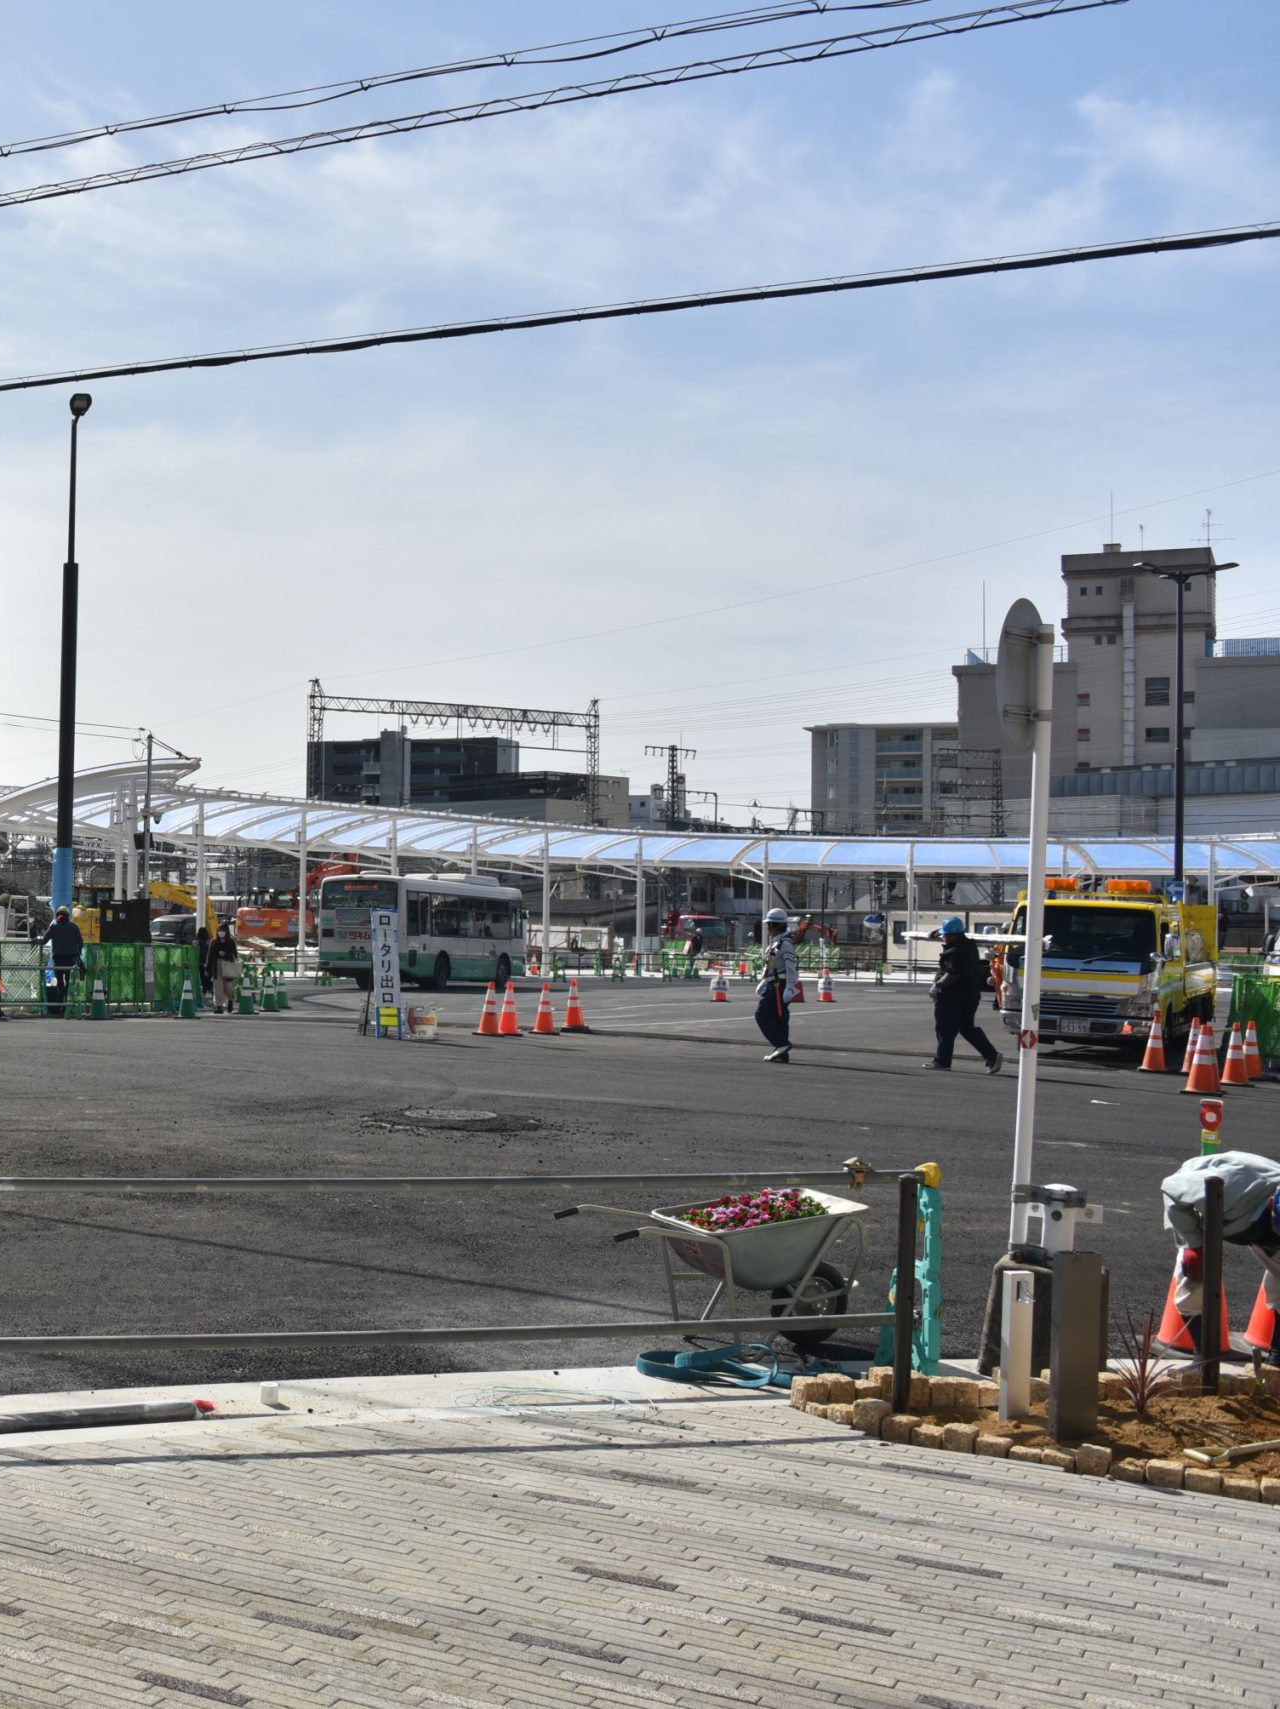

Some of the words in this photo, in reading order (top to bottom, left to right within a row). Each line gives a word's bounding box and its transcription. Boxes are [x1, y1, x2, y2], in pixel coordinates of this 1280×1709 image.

[379, 915, 394, 1003] ロータリ出口
